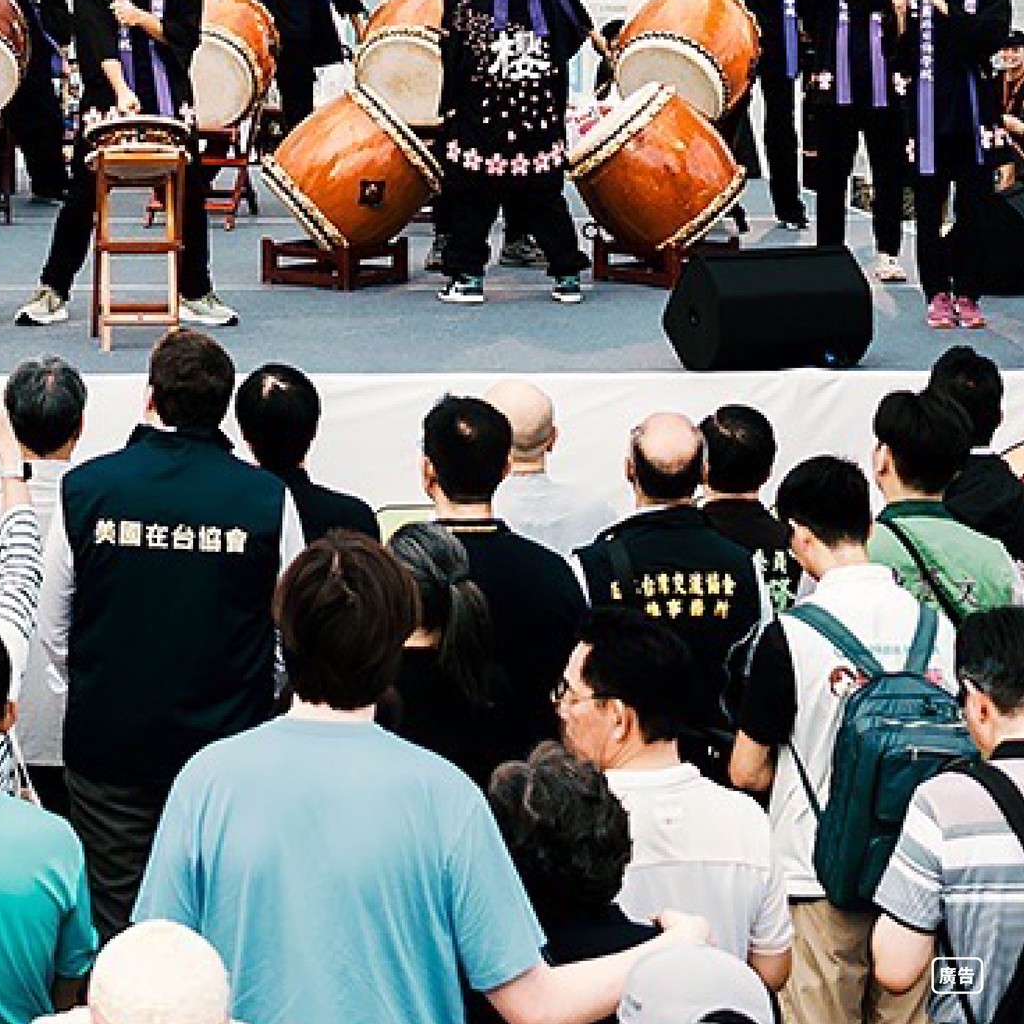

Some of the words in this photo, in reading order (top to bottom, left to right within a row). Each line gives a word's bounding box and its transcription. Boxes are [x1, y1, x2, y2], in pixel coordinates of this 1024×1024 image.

[93, 517, 249, 554] 美國在台協會
